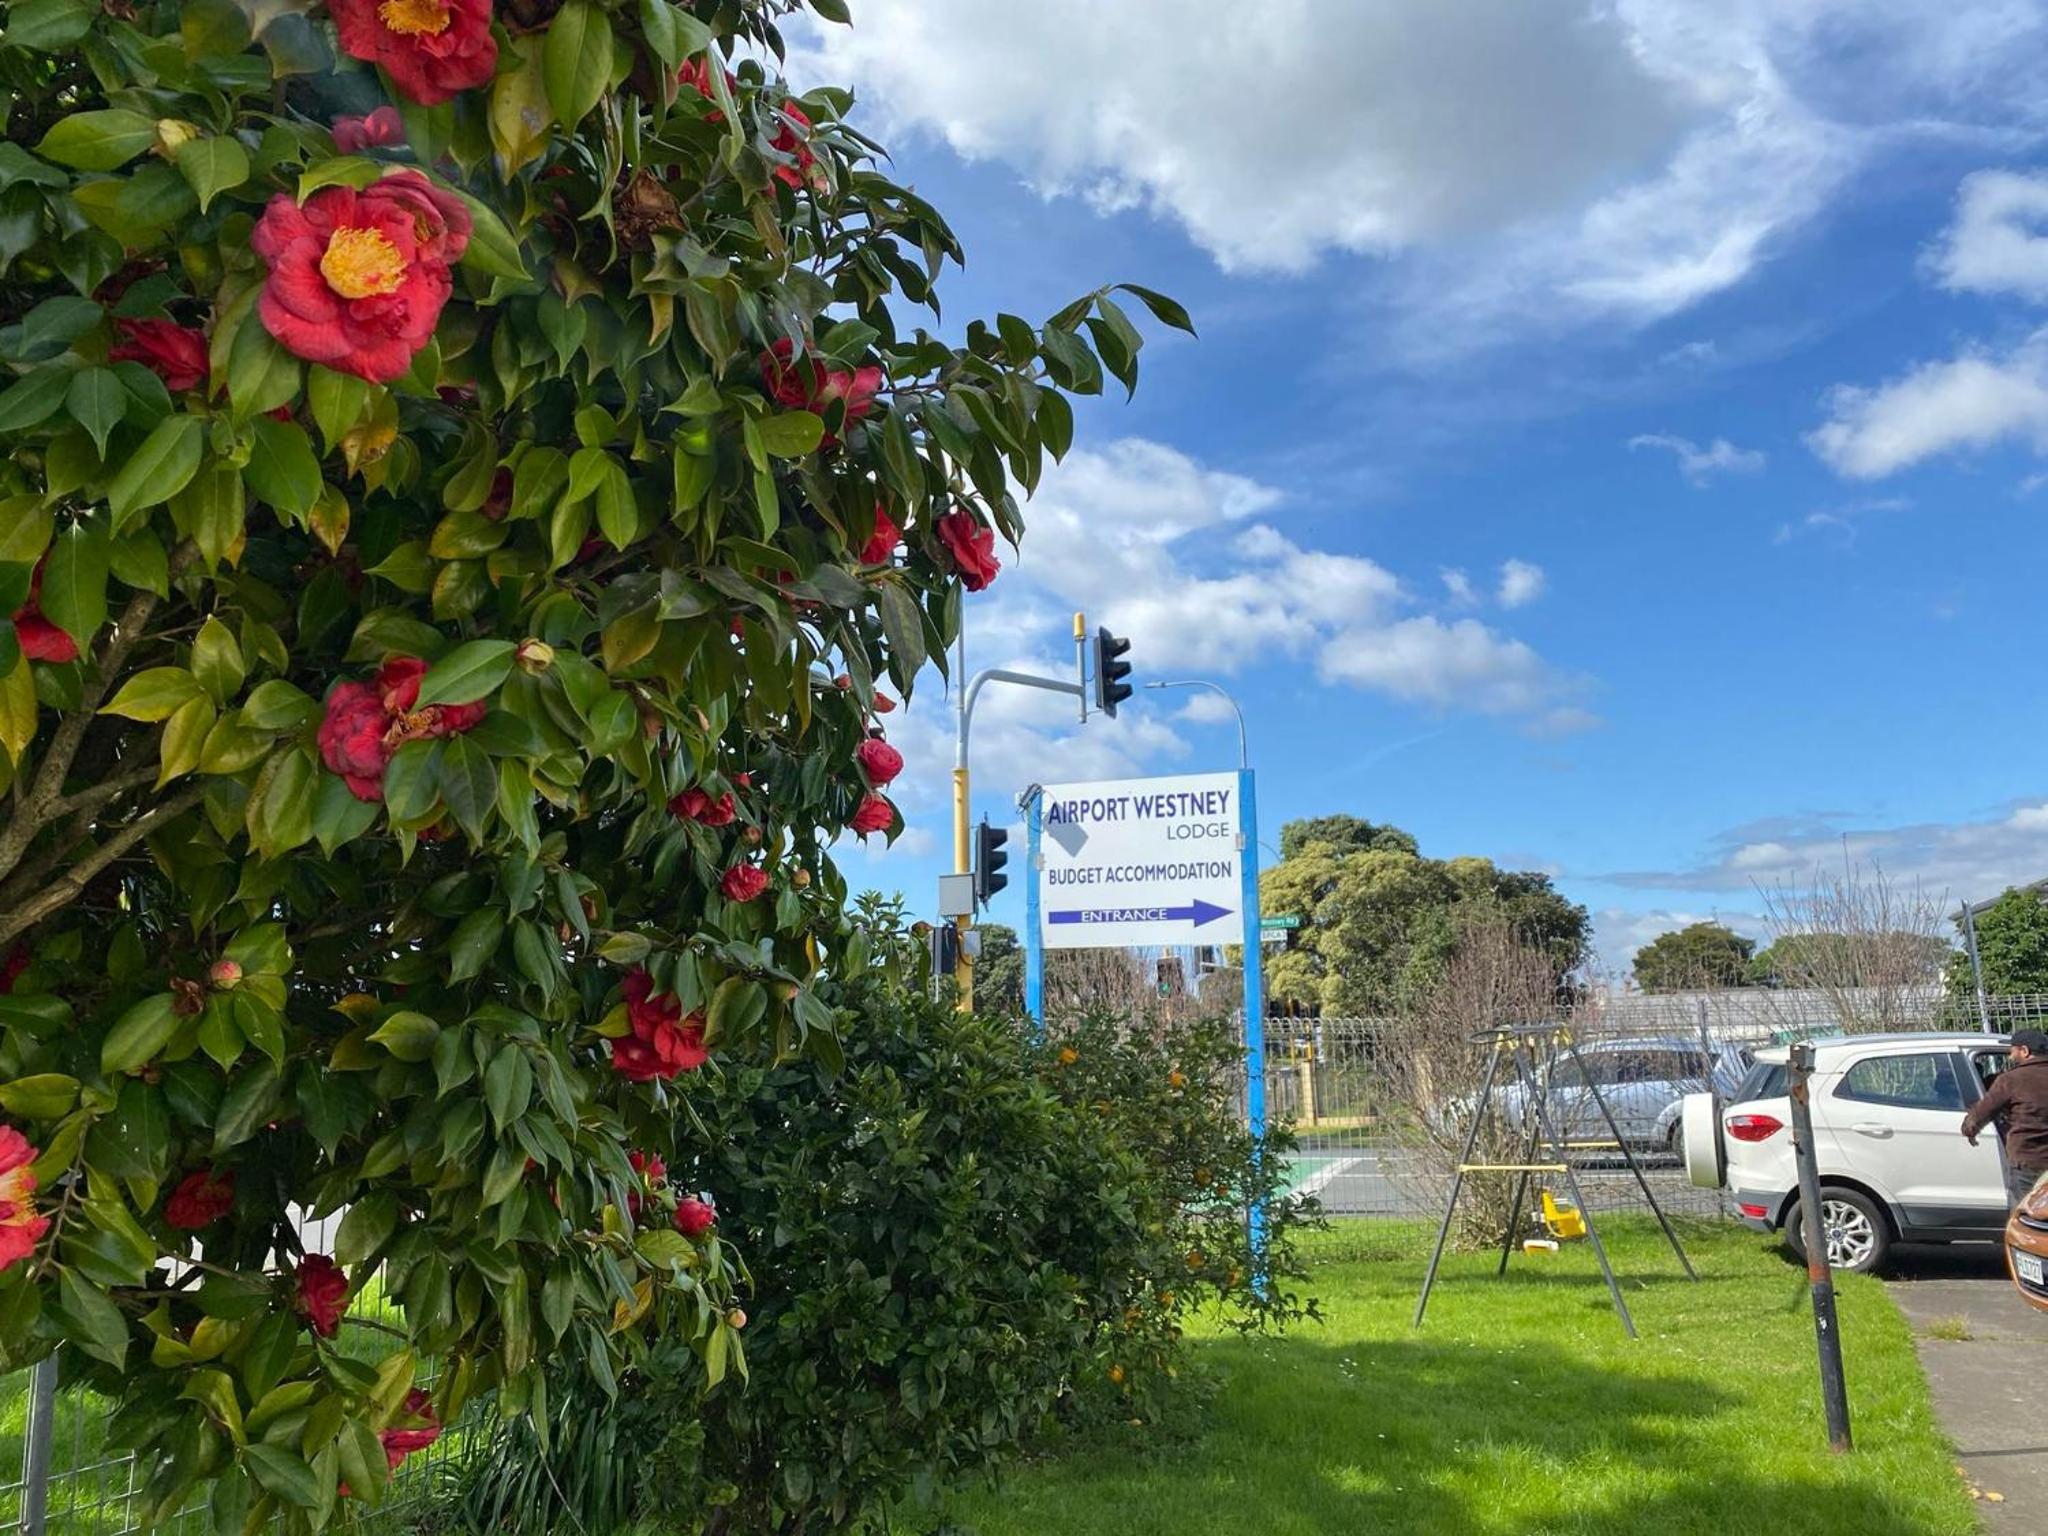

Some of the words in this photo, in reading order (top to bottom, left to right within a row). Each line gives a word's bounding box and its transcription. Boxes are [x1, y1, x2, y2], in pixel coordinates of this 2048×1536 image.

[1048, 797, 1130, 824] AIRPORT
[1133, 790, 1230, 819] WESTNEY
[1167, 822, 1229, 840] LODGE
[1049, 867, 1103, 885] BUDGET
[1105, 861, 1232, 882] ACCOMMODATION
[1081, 909, 1168, 922] ENTRANCE
